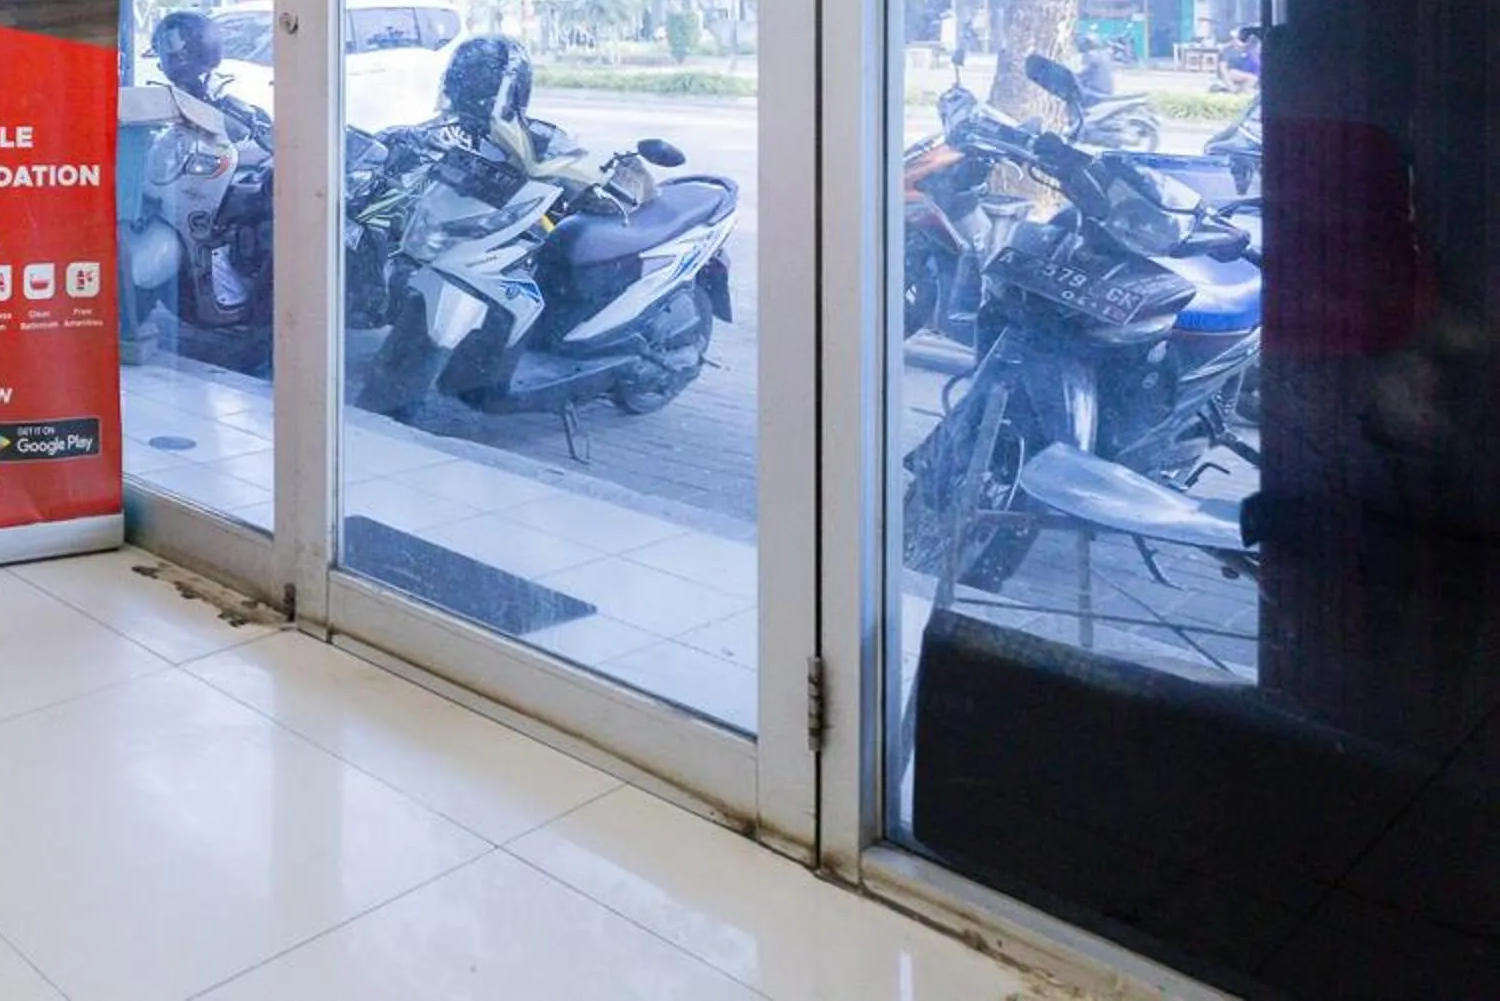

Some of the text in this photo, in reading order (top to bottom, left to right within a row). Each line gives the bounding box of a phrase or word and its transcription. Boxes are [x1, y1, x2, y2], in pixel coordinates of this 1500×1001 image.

[17, 426, 56, 436] GET IT ON
[17, 434, 94, 456] Google Play
